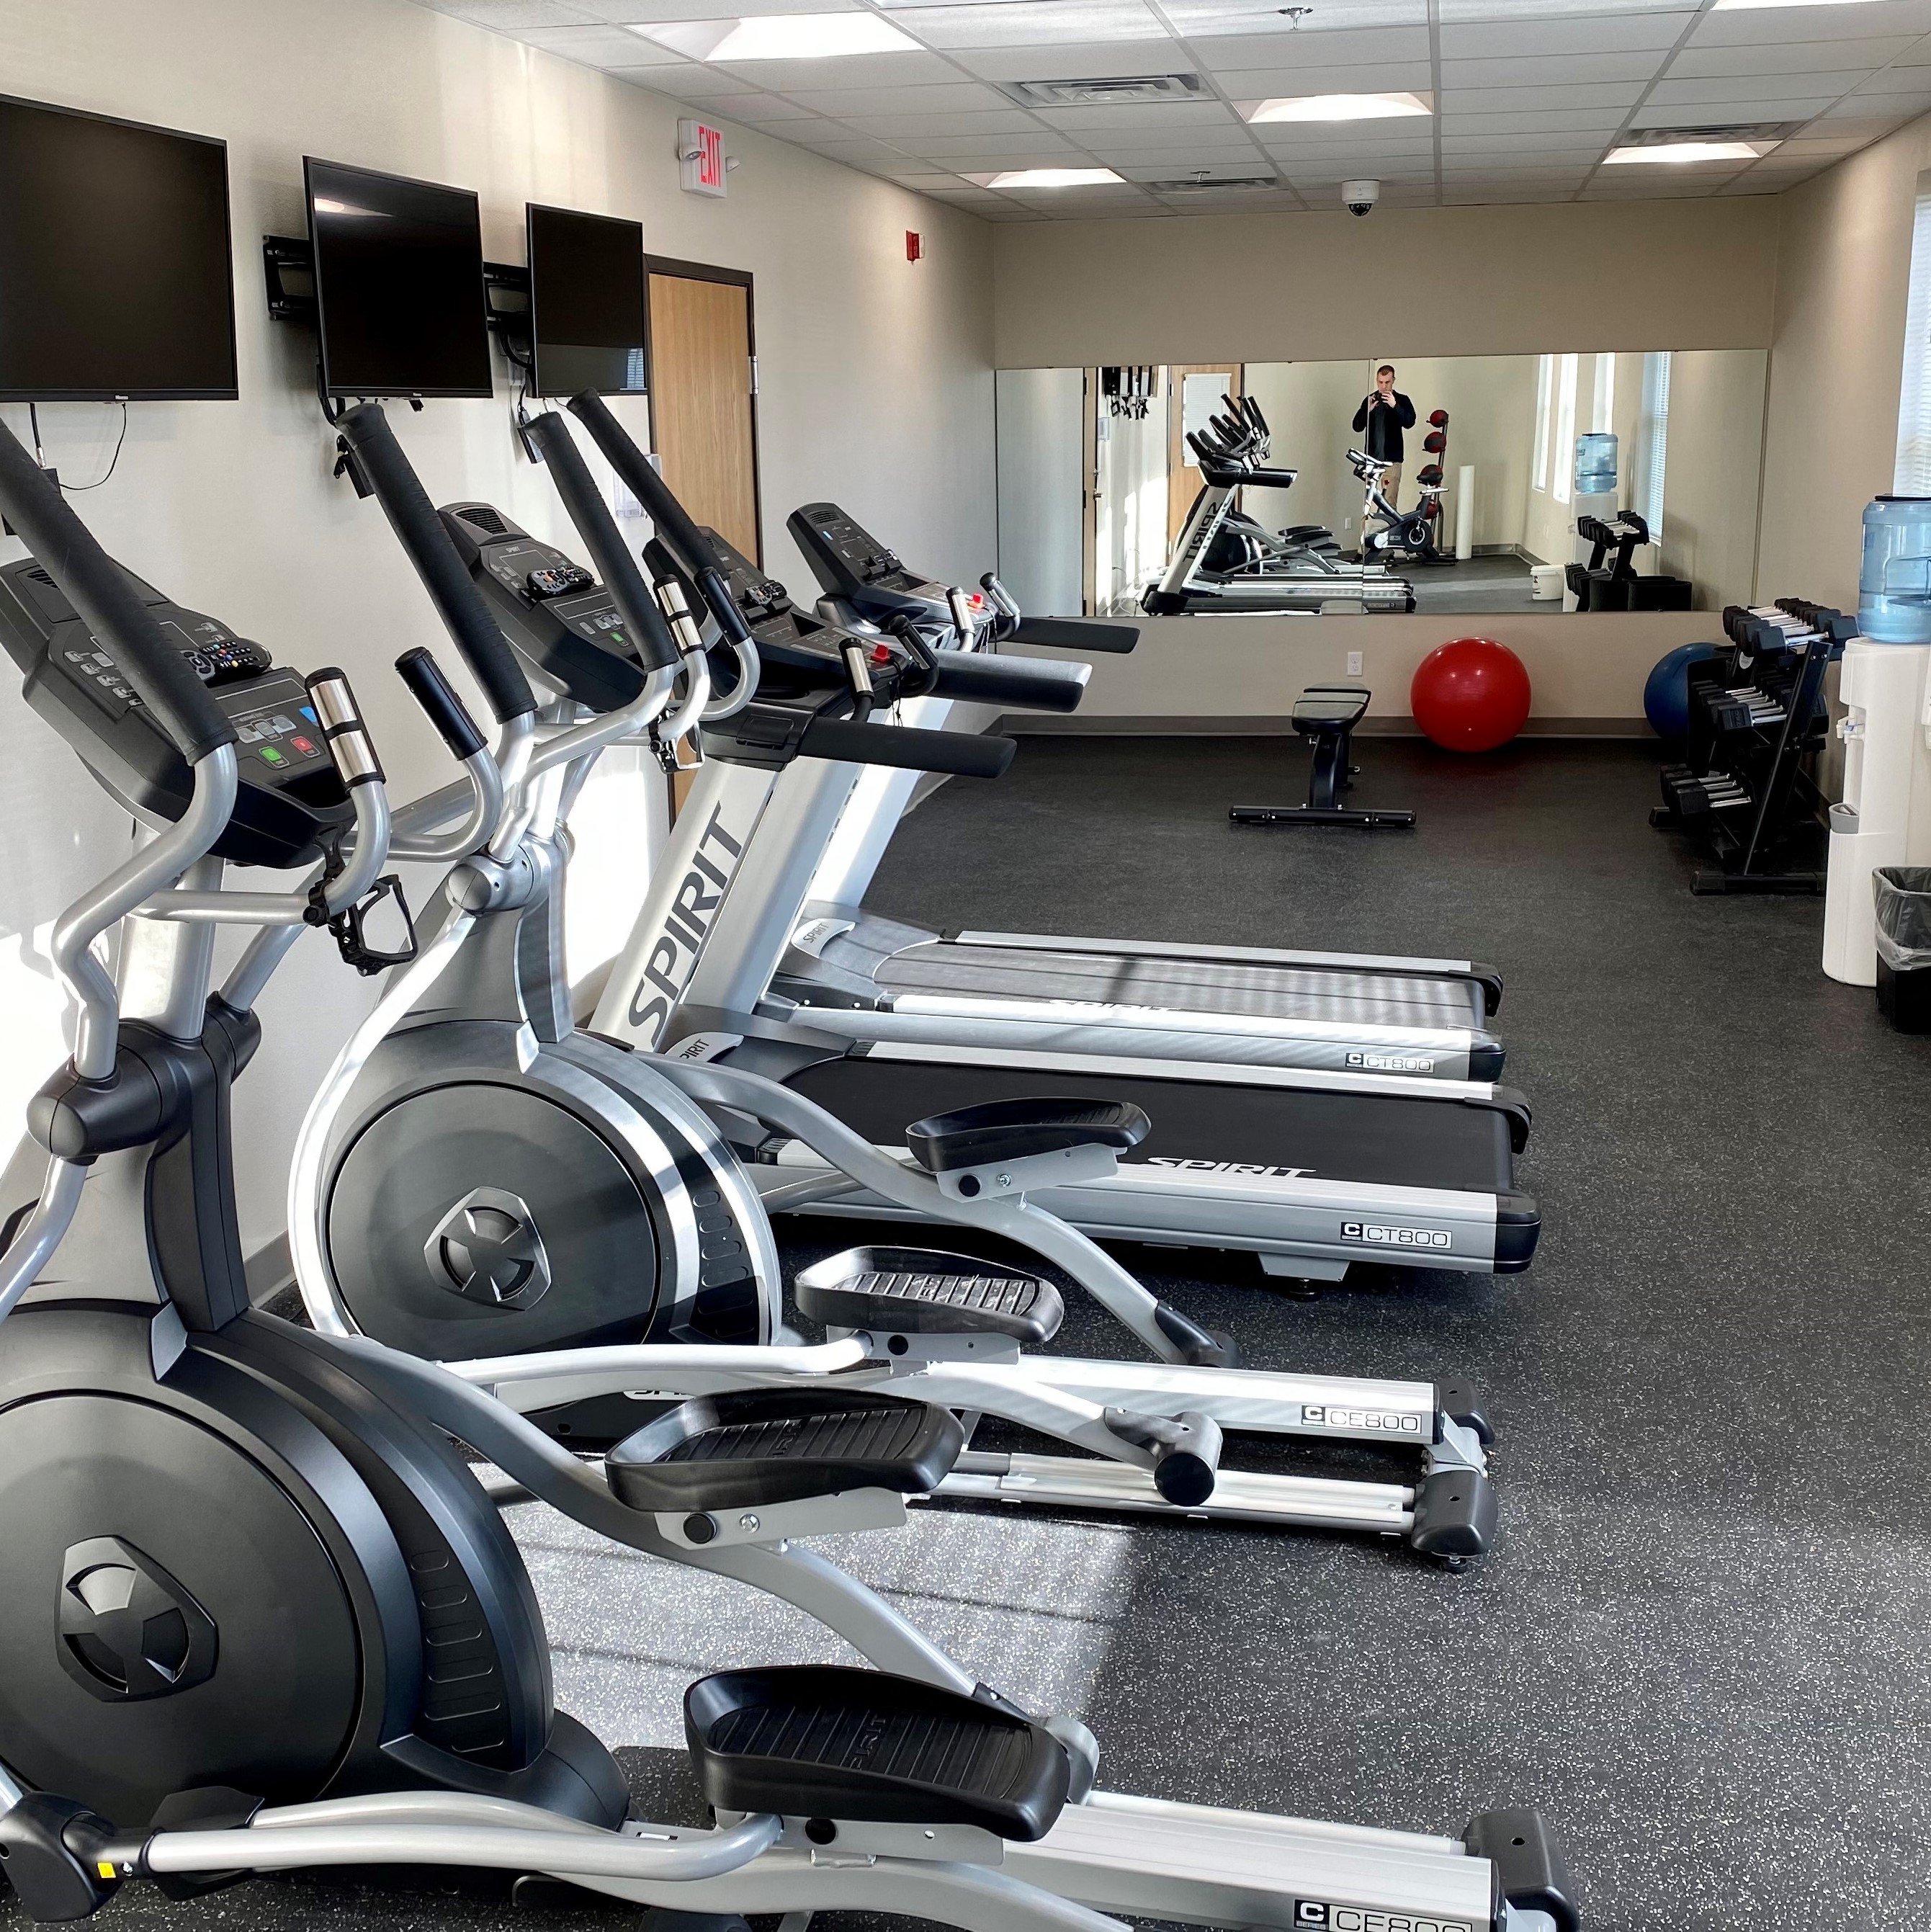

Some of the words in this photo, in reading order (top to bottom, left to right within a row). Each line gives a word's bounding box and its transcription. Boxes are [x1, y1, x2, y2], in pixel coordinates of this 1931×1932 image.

[699, 126, 721, 187] EXIT
[628, 800, 742, 1048] SPIRIT
[803, 923, 829, 943] SPIRIT
[1367, 1057, 1430, 1070] CT800
[1147, 1157, 1317, 1177] SPIRIT
[1344, 1223, 1360, 1235] C
[1368, 1227, 1448, 1245] CT800
[1330, 1410, 1417, 1431] CE800
[1300, 1902, 1324, 1922] C
